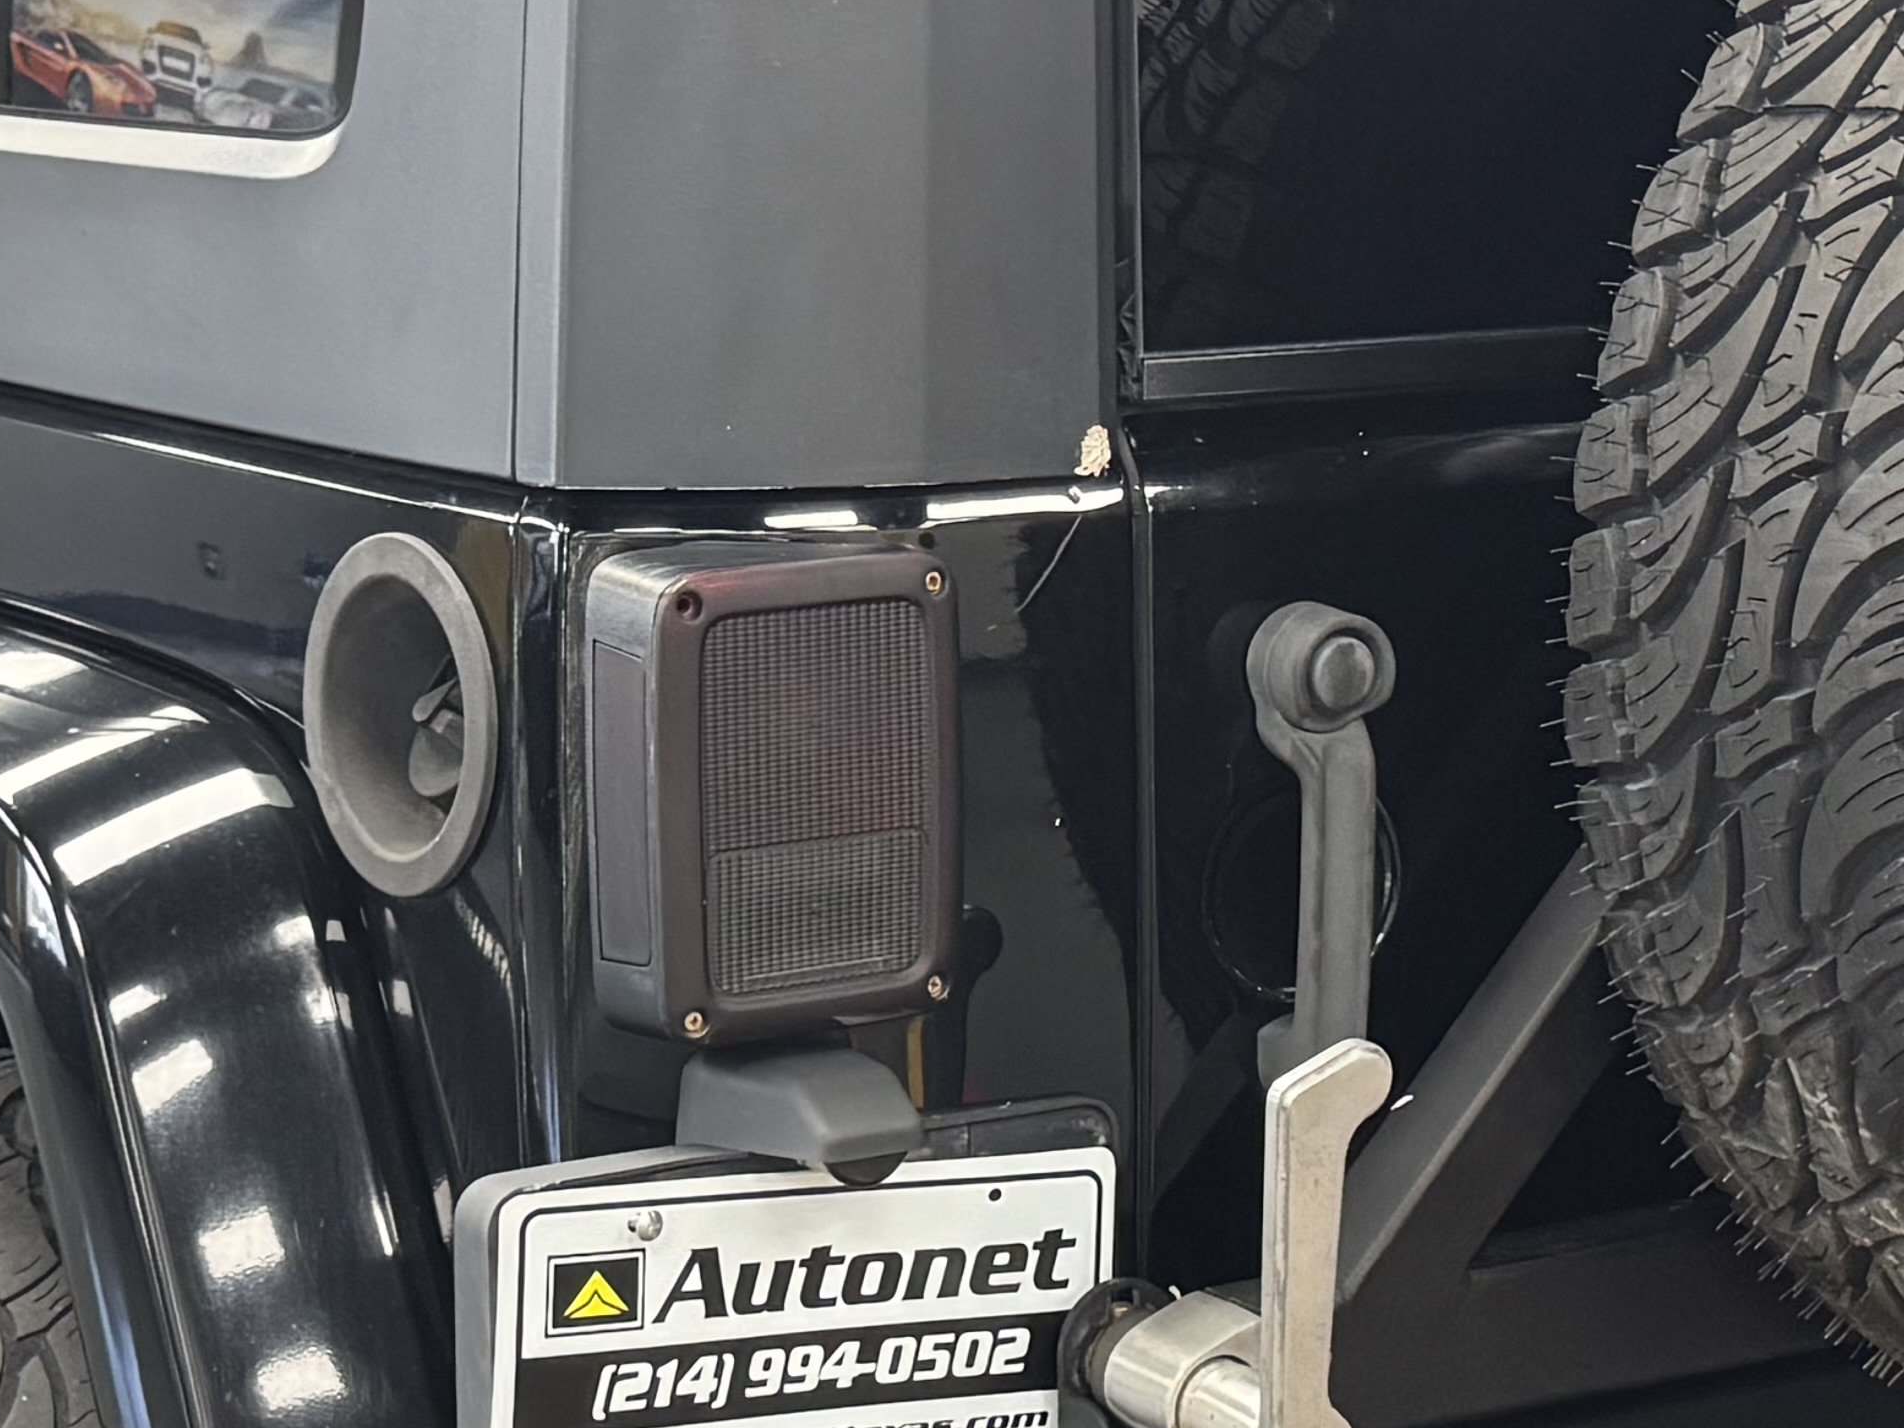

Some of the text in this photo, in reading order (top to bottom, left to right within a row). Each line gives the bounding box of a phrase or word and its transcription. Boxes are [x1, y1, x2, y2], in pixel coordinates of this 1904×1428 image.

[652, 1227, 1077, 1325] Autonet
[592, 1326, 1031, 1422] (214) 994-0502
